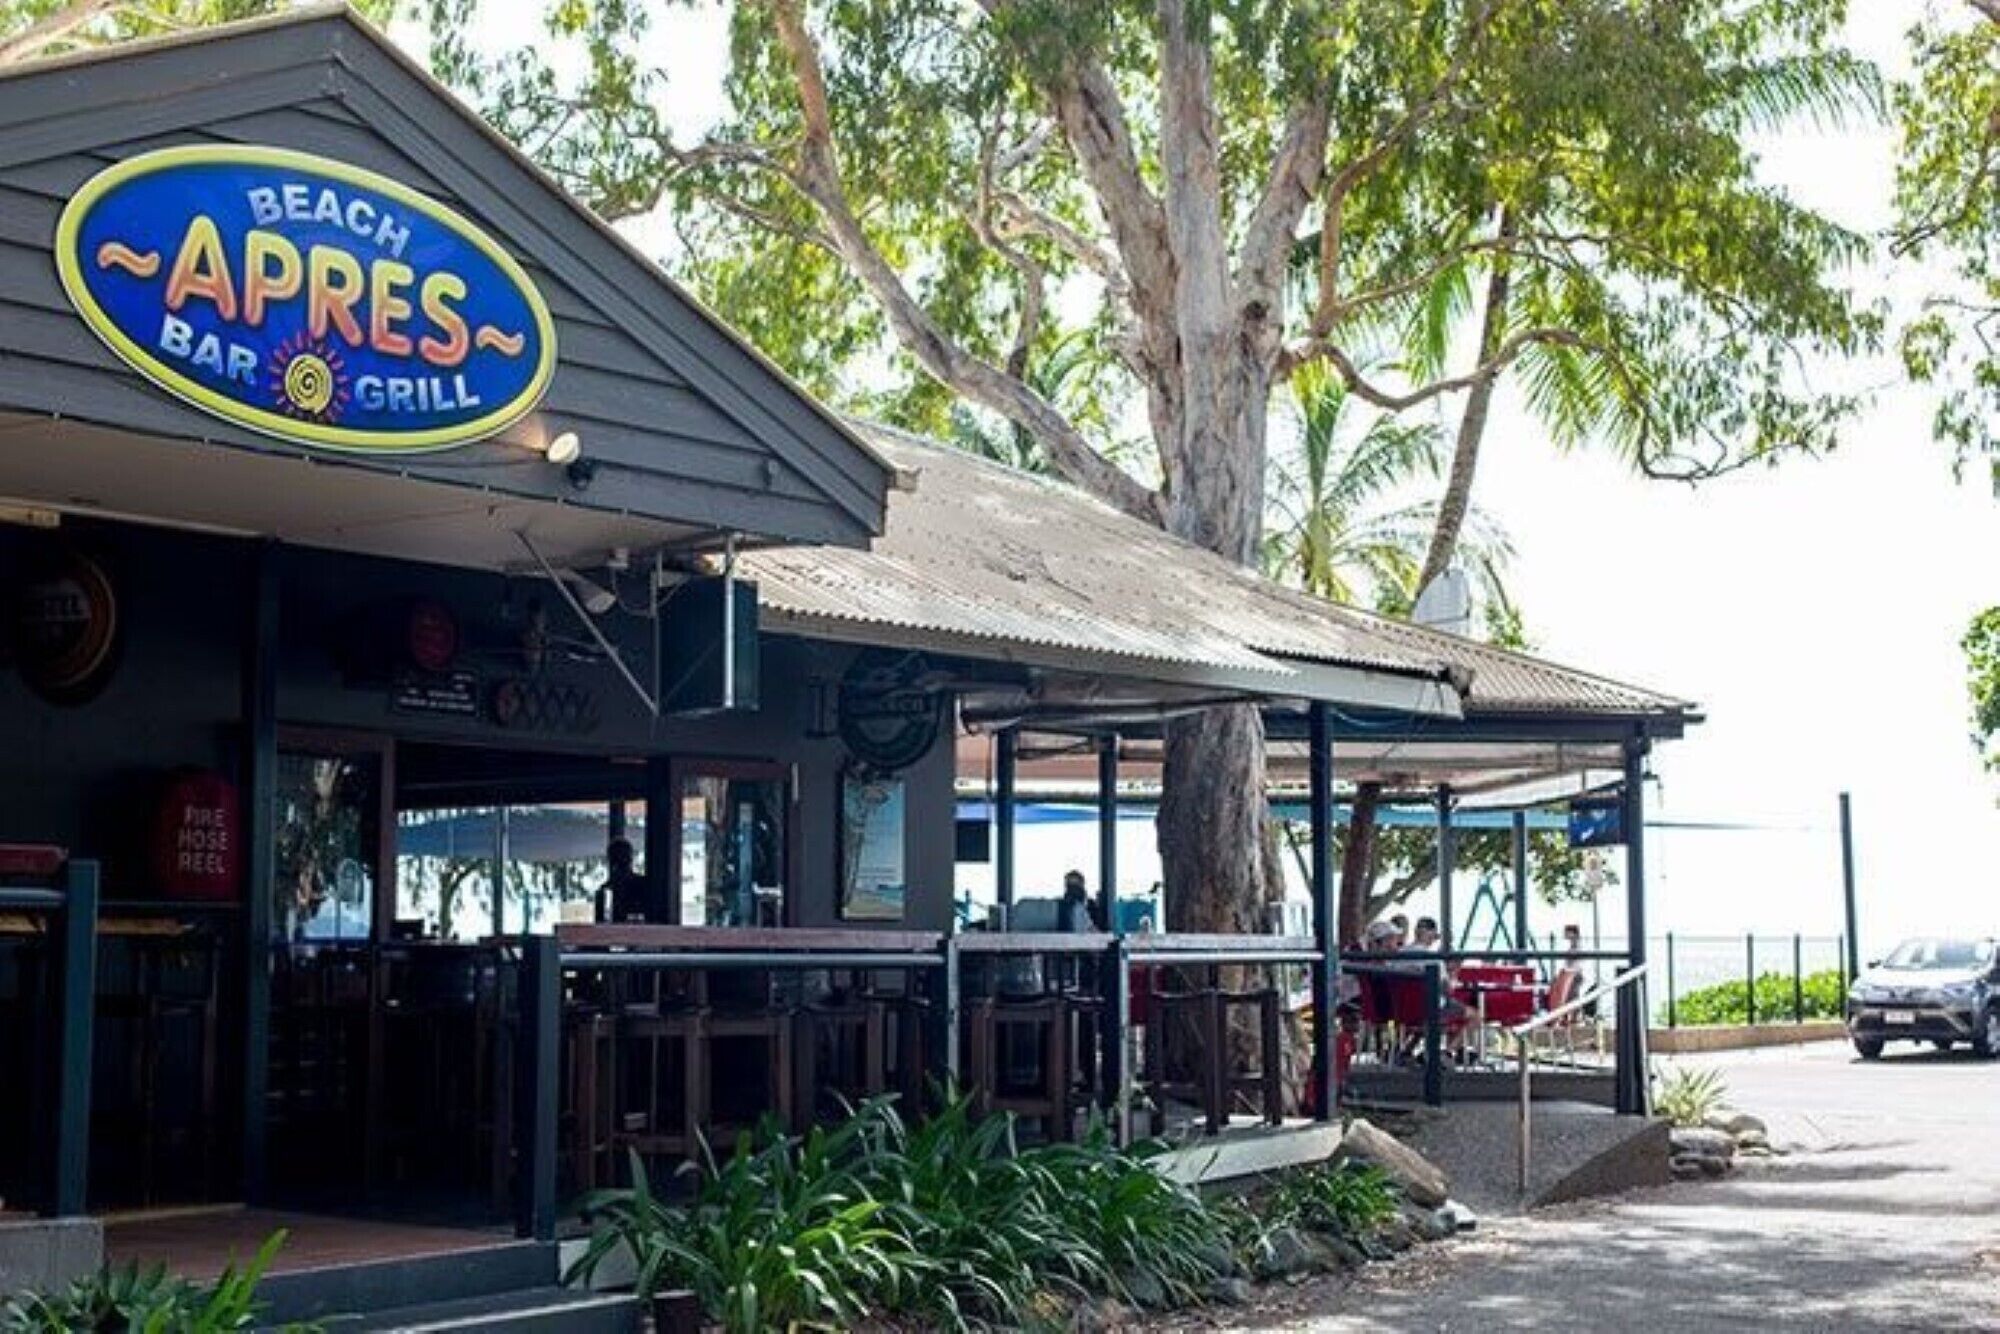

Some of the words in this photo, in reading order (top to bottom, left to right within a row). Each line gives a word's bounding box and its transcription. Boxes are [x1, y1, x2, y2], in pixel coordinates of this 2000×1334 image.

[248, 183, 411, 258] BEACH
[165, 214, 471, 367] APRES
[159, 313, 260, 386] BAR
[353, 374, 481, 413] GRILL
[177, 826, 229, 851] HOSE
[184, 803, 225, 828] FIRE
[177, 851, 227, 875] REEL
